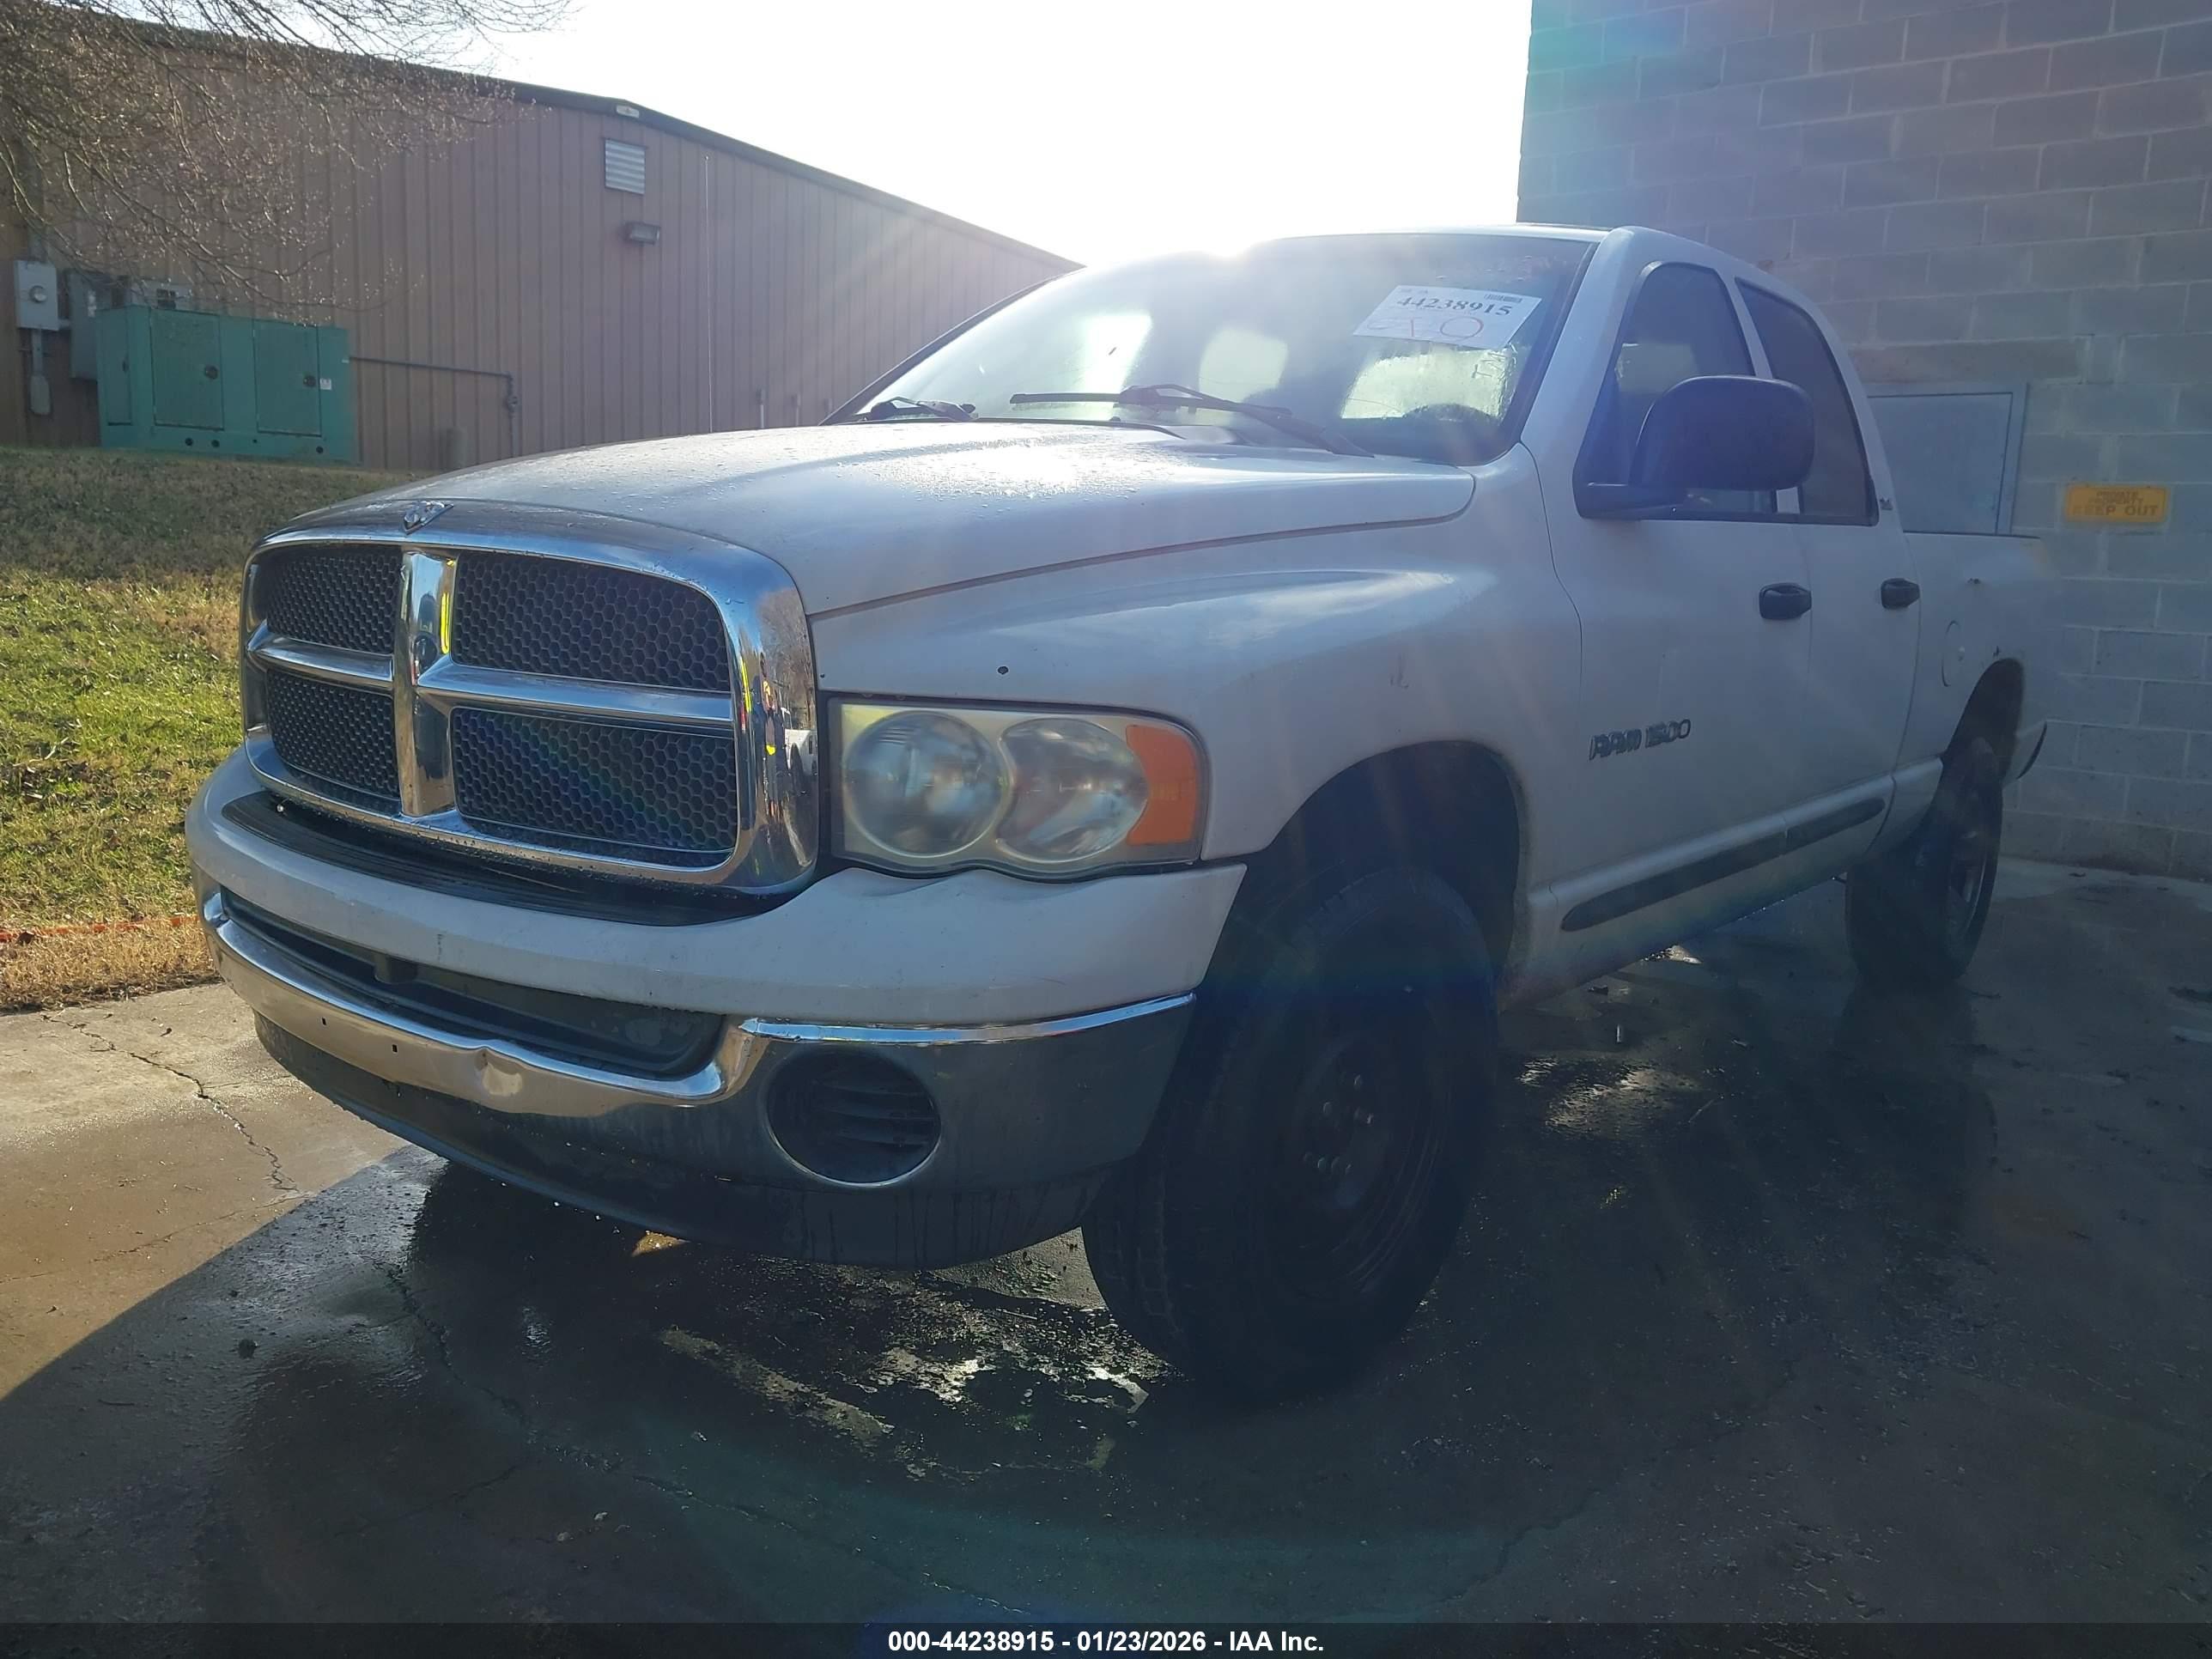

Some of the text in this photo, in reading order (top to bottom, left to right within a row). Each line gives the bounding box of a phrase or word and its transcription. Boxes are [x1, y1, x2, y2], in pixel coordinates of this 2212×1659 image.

[1397, 296, 1513, 316] 44238915
[2124, 505, 2159, 516] OUT
[1589, 719, 1692, 761] RAM 1500
